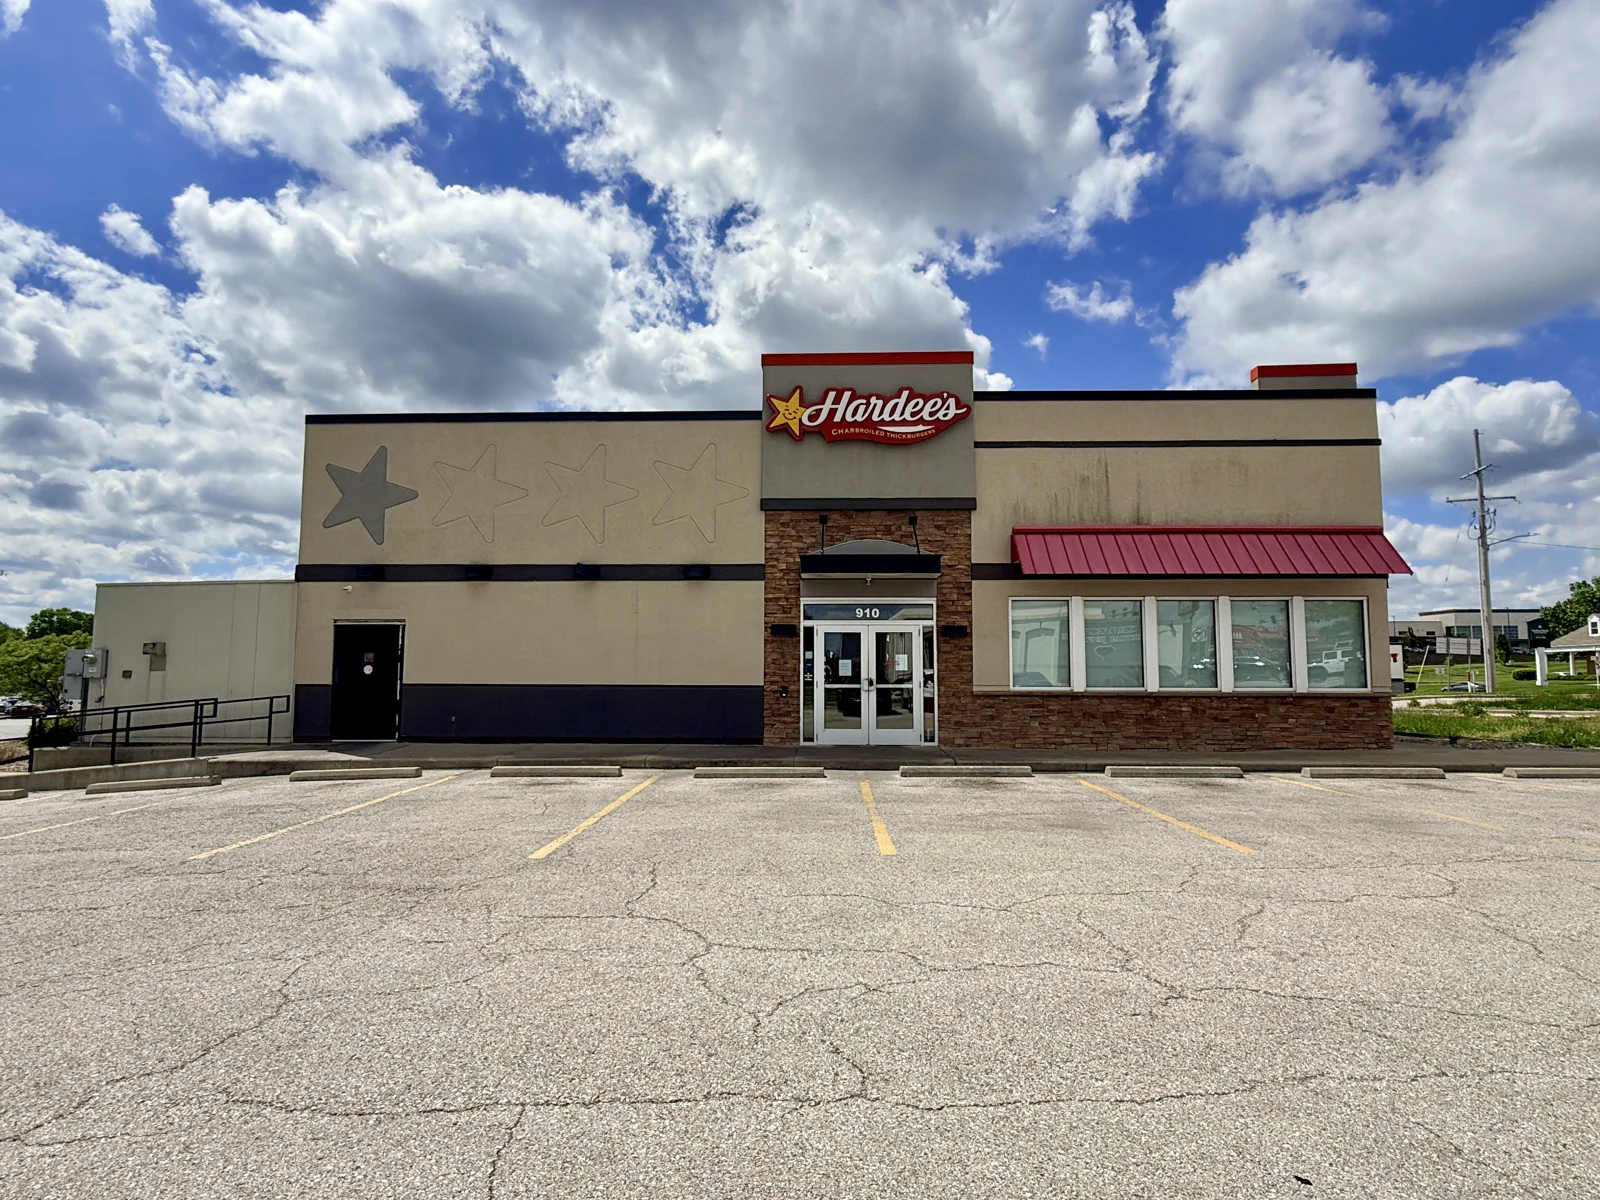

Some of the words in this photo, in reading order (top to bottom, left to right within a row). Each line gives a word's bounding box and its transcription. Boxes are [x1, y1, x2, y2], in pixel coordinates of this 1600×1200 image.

[801, 390, 968, 426] Hardee's
[831, 427, 885, 437] CHARBROILED
[886, 428, 936, 439] THICKBURGERS
[855, 608, 880, 618] 910
